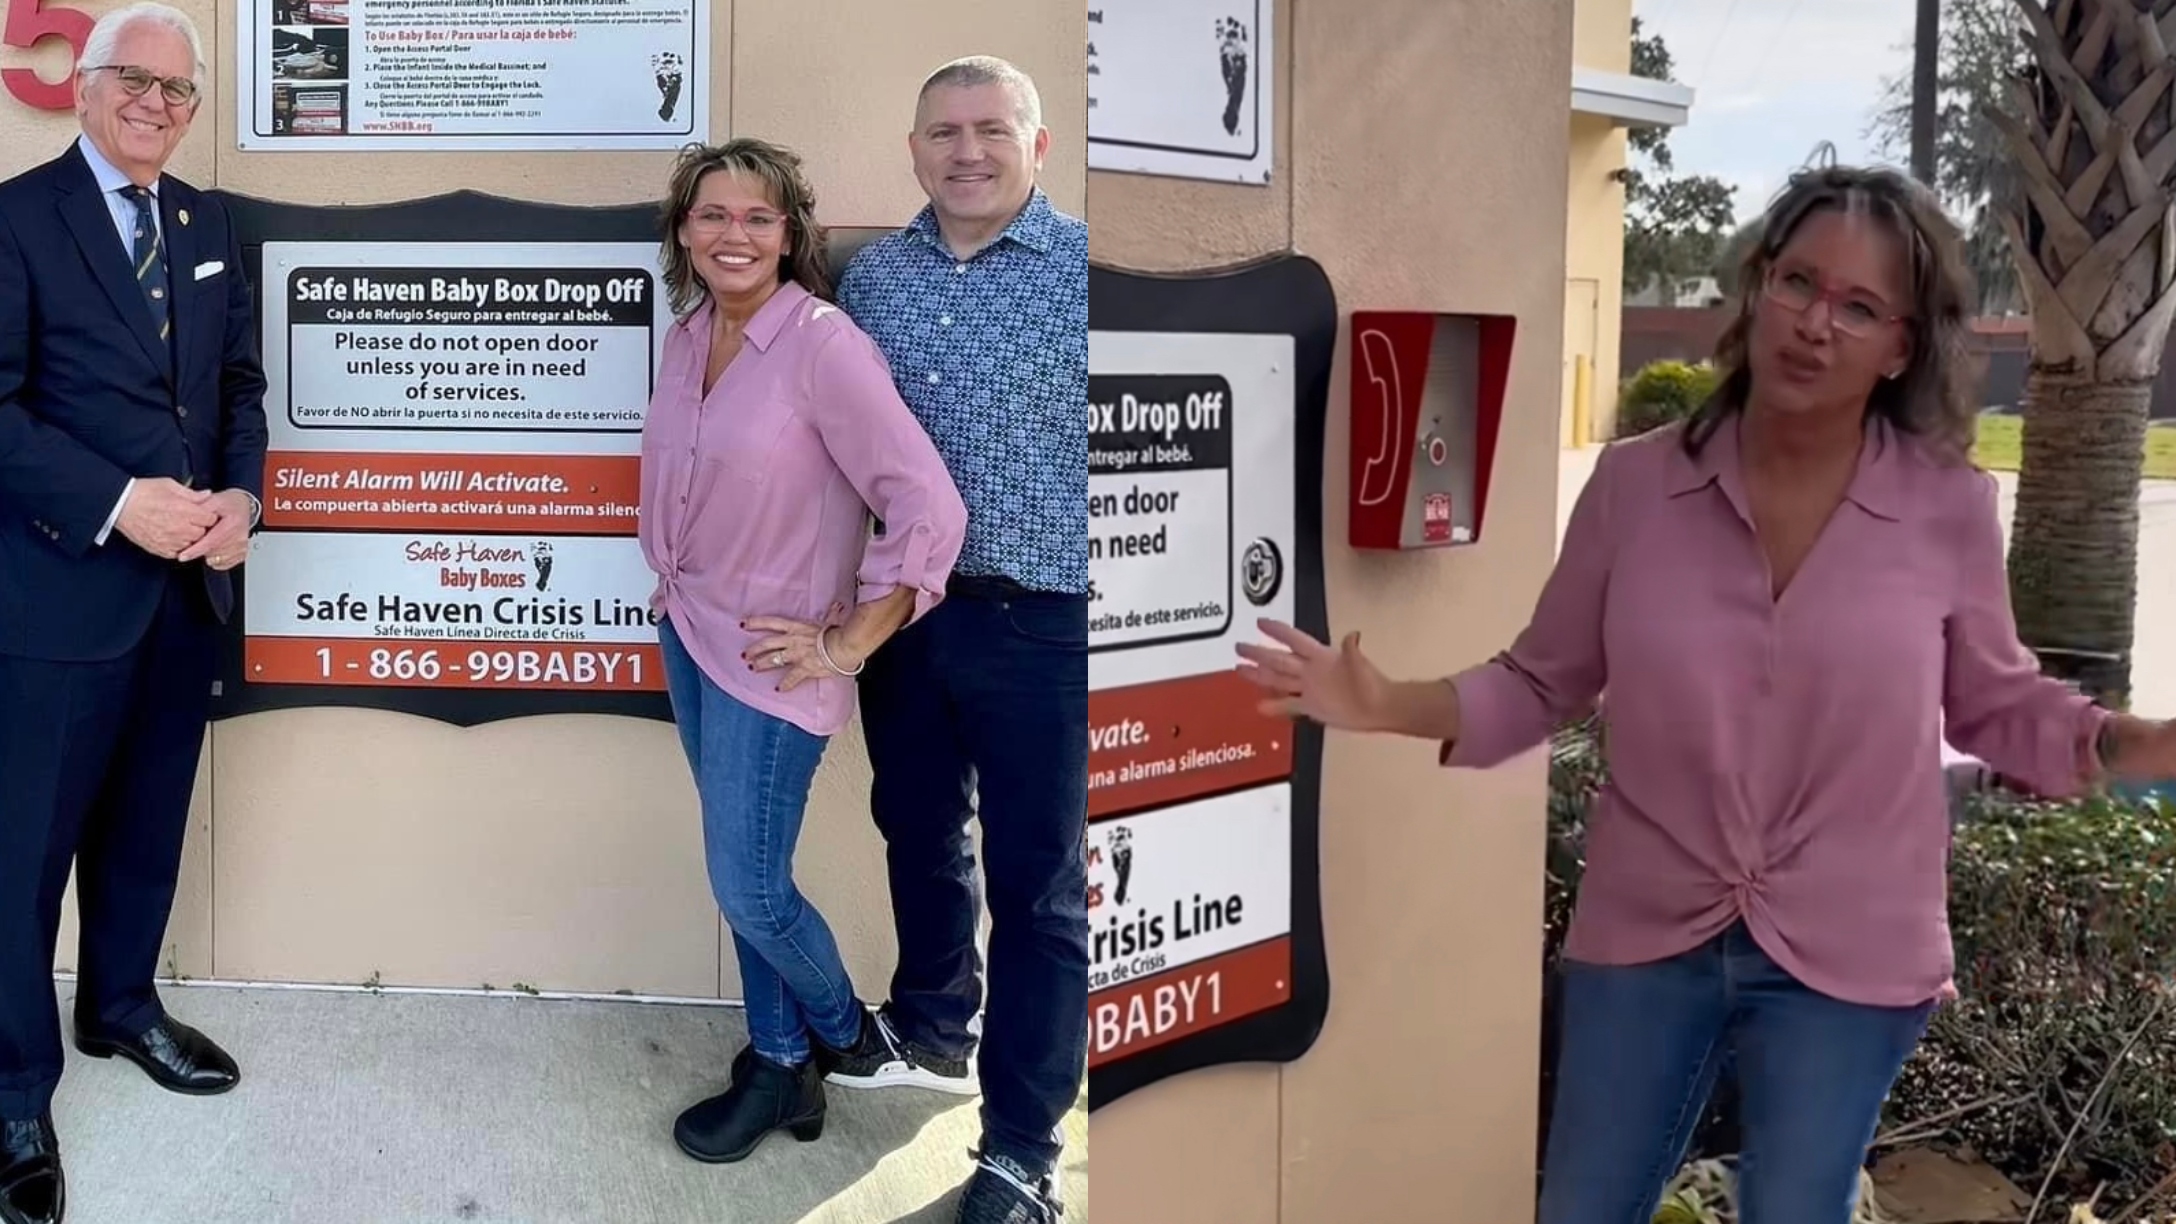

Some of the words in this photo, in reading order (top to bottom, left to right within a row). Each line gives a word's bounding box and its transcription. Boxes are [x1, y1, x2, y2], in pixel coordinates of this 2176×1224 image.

[365, 31, 377, 40] To
[379, 31, 396, 40] Use
[398, 30, 422, 42] Baby
[425, 30, 443, 40] Box
[452, 30, 474, 39] Para
[476, 31, 498, 39] usar
[500, 29, 509, 39] la
[511, 29, 532, 41] caja
[534, 29, 546, 39] de
[1, 0, 97, 110] 5
[296, 277, 347, 302] Safe
[353, 278, 424, 302] Haven
[431, 278, 488, 307] Baby
[495, 279, 538, 302] Box
[545, 279, 600, 308] Drop
[606, 278, 644, 303] Off
[326, 308, 353, 322] Caja
[356, 308, 372, 320] de
[375, 308, 423, 322] Refugio
[426, 309, 471, 323] Seguro
[474, 312, 502, 323] para
[505, 311, 560, 323] entregar
[563, 309, 575, 321] al
[577, 308, 613, 322] bebé.
[335, 332, 403, 351] Please
[409, 332, 436, 351] do
[443, 335, 478, 351] not
[485, 338, 540, 356] open
[547, 333, 598, 352] door
[347, 357, 414, 375] unless
[420, 362, 459, 379] you
[466, 363, 499, 376] are
[506, 358, 525, 376] in
[533, 358, 586, 377] need
[406, 382, 429, 400] of
[434, 383, 526, 401] services.
[297, 406, 331, 417] Favor
[333, 406, 348, 417] de
[351, 406, 370, 417] NO
[372, 407, 402, 418] abrir
[405, 408, 415, 418] la
[418, 409, 458, 421] puerta
[462, 410, 470, 419] si
[473, 411, 490, 419] no
[493, 409, 542, 420] necesita
[546, 409, 561, 420] de
[564, 411, 589, 420] este
[593, 410, 643, 421] servicio.
[1121, 394, 1180, 441] Drop
[1186, 392, 1223, 430] Off
[1141, 446, 1153, 464] al
[1156, 444, 1193, 463] bebé.
[275, 468, 340, 489] Silent
[343, 469, 413, 490] Alarm
[420, 470, 463, 491] Will
[467, 472, 569, 493] Activate.
[275, 497, 291, 511] La
[295, 500, 378, 514] compuerta
[382, 499, 437, 514] abierta
[440, 501, 503, 515] activará
[507, 503, 536, 516] una
[540, 502, 594, 517] alarma
[1088, 492, 1117, 517] en
[1124, 485, 1179, 515] door
[404, 541, 451, 562] Safe
[455, 540, 526, 563] Haven
[1109, 524, 1167, 558] need
[441, 567, 477, 593] Baby
[480, 568, 526, 589] Boxes
[296, 593, 368, 622] Safe
[377, 596, 482, 625] Haven
[493, 597, 583, 626] Crisis
[594, 598, 659, 627] Line
[1088, 613, 1122, 632] esita
[1125, 611, 1142, 628] de
[1144, 607, 1172, 626] este
[1174, 602, 1224, 622] servicio.
[374, 625, 401, 637] Safe
[404, 626, 444, 638] Haven
[447, 625, 480, 639] Línea
[484, 627, 530, 640] Directa
[533, 628, 549, 640] de
[552, 629, 586, 641] Crisis
[1088, 719, 1150, 752] vate.
[1119, 758, 1176, 783] alarma
[1179, 743, 1256, 774] silenciosa.
[1088, 907, 1164, 967] risis
[1174, 893, 1242, 943] Line
[1111, 963, 1129, 982] de
[1131, 952, 1167, 976] Crisis
[1088, 971, 1221, 1053] BABY1
